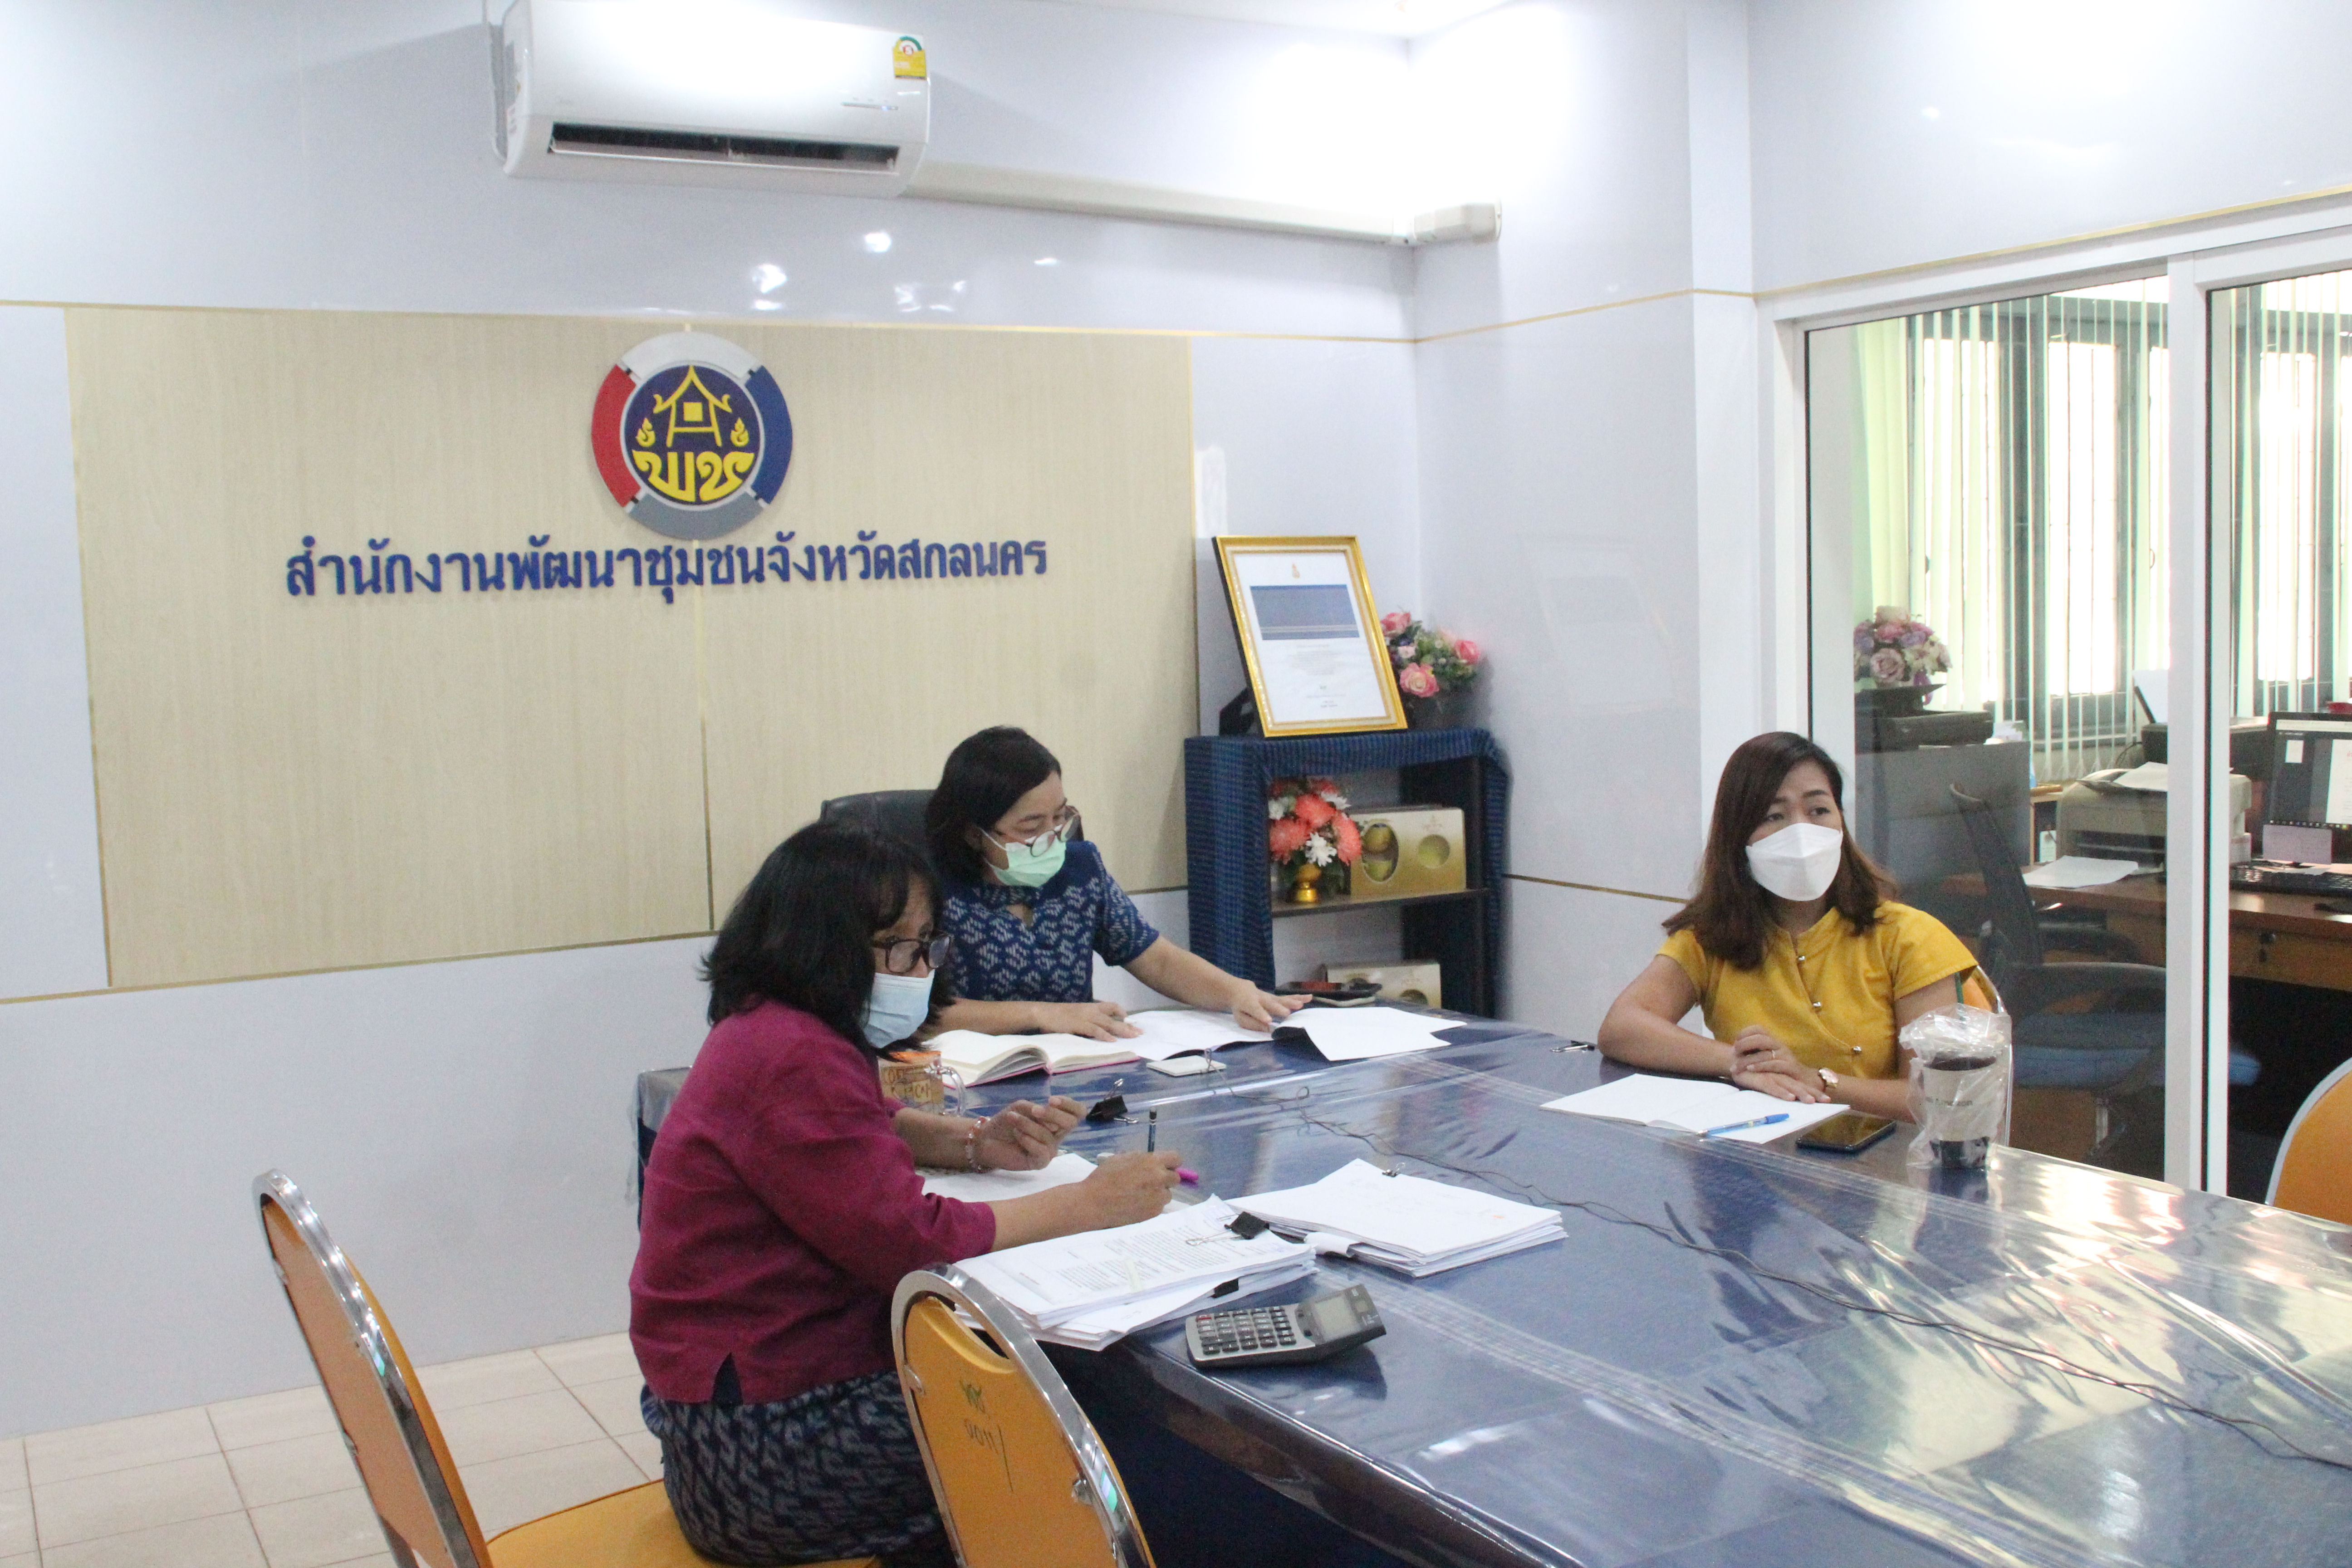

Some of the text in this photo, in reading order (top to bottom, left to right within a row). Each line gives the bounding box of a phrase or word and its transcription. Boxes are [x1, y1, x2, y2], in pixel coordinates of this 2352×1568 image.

[287, 531, 1046, 603] สำนักงานพัฒนาชุมชนจังหวัดสกลนคร
